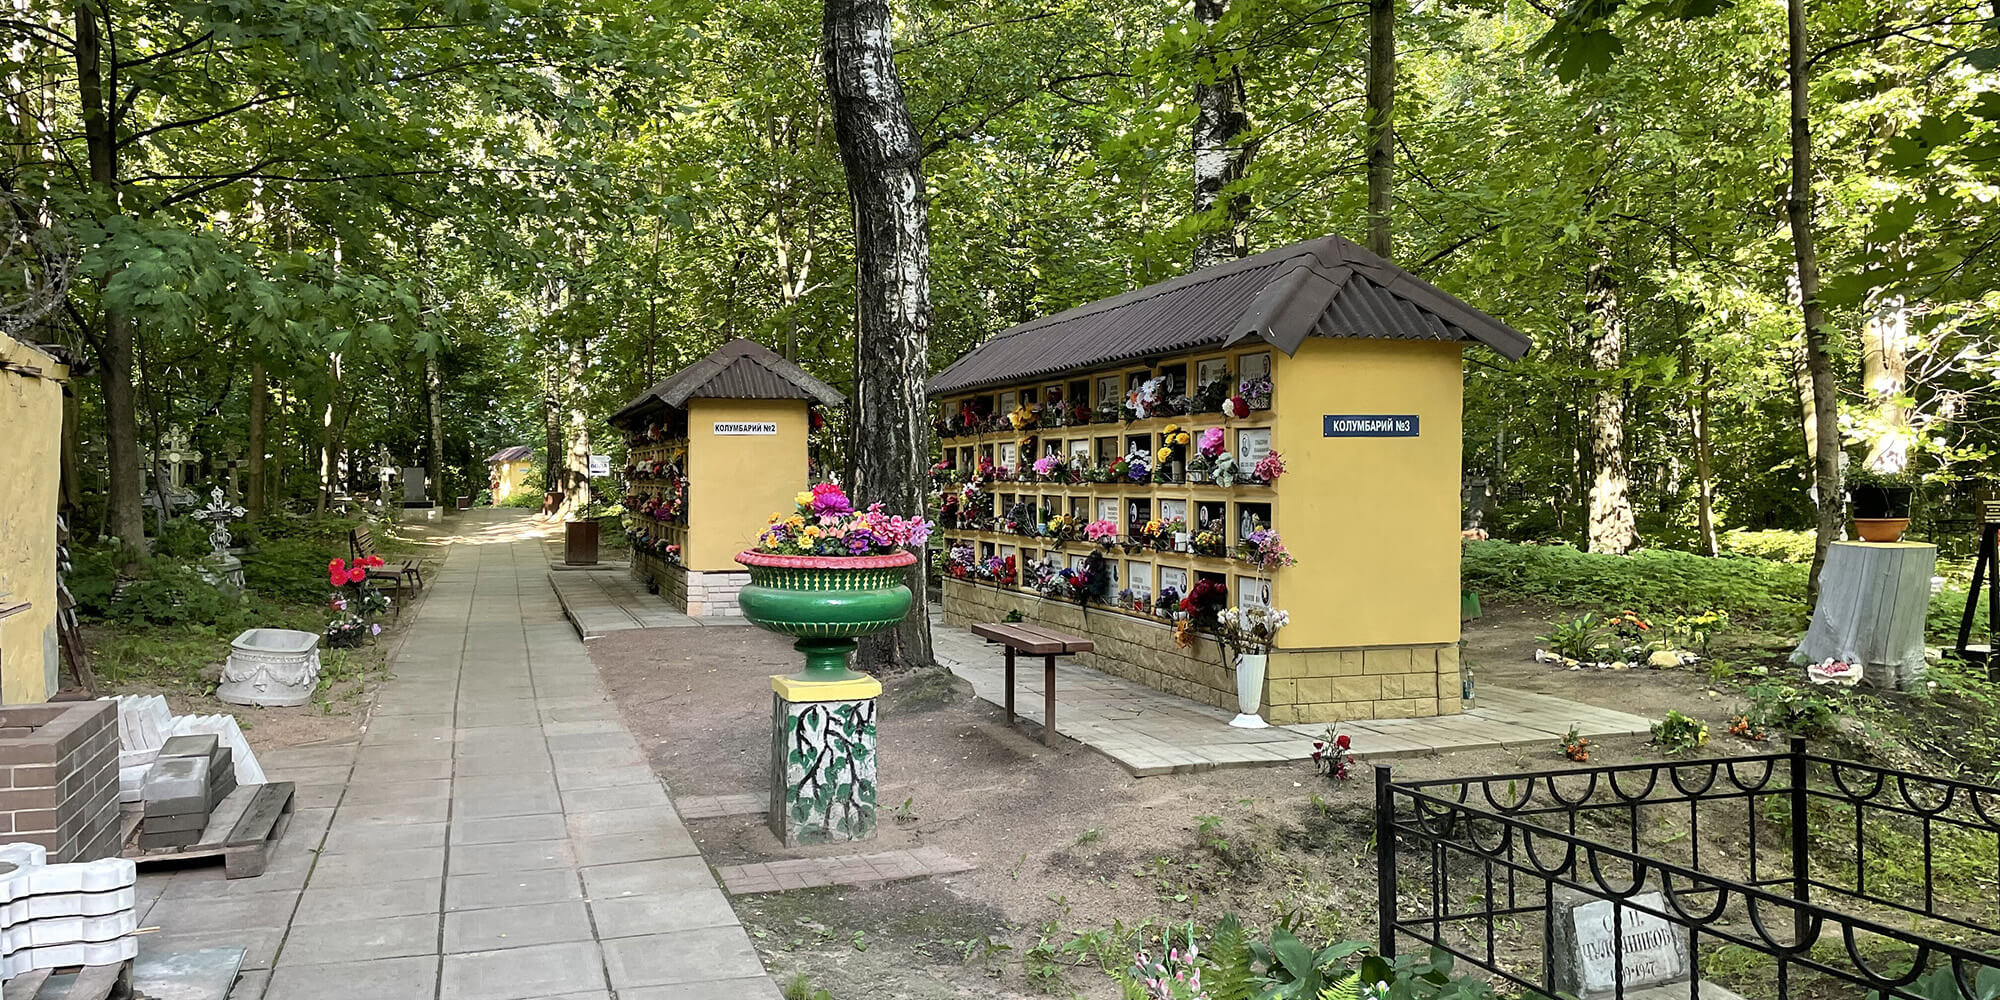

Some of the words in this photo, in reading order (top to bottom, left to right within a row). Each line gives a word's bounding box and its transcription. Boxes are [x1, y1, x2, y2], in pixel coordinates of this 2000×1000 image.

[714, 423, 762, 432] КОЛУМБАРИЙ
[763, 424, 776, 432] №2
[1333, 418, 1394, 432] КОЛУМБАРИЙ
[1395, 420, 1410, 432] №3
[1582, 928, 1671, 961] ЧУЛОНИКОВ
